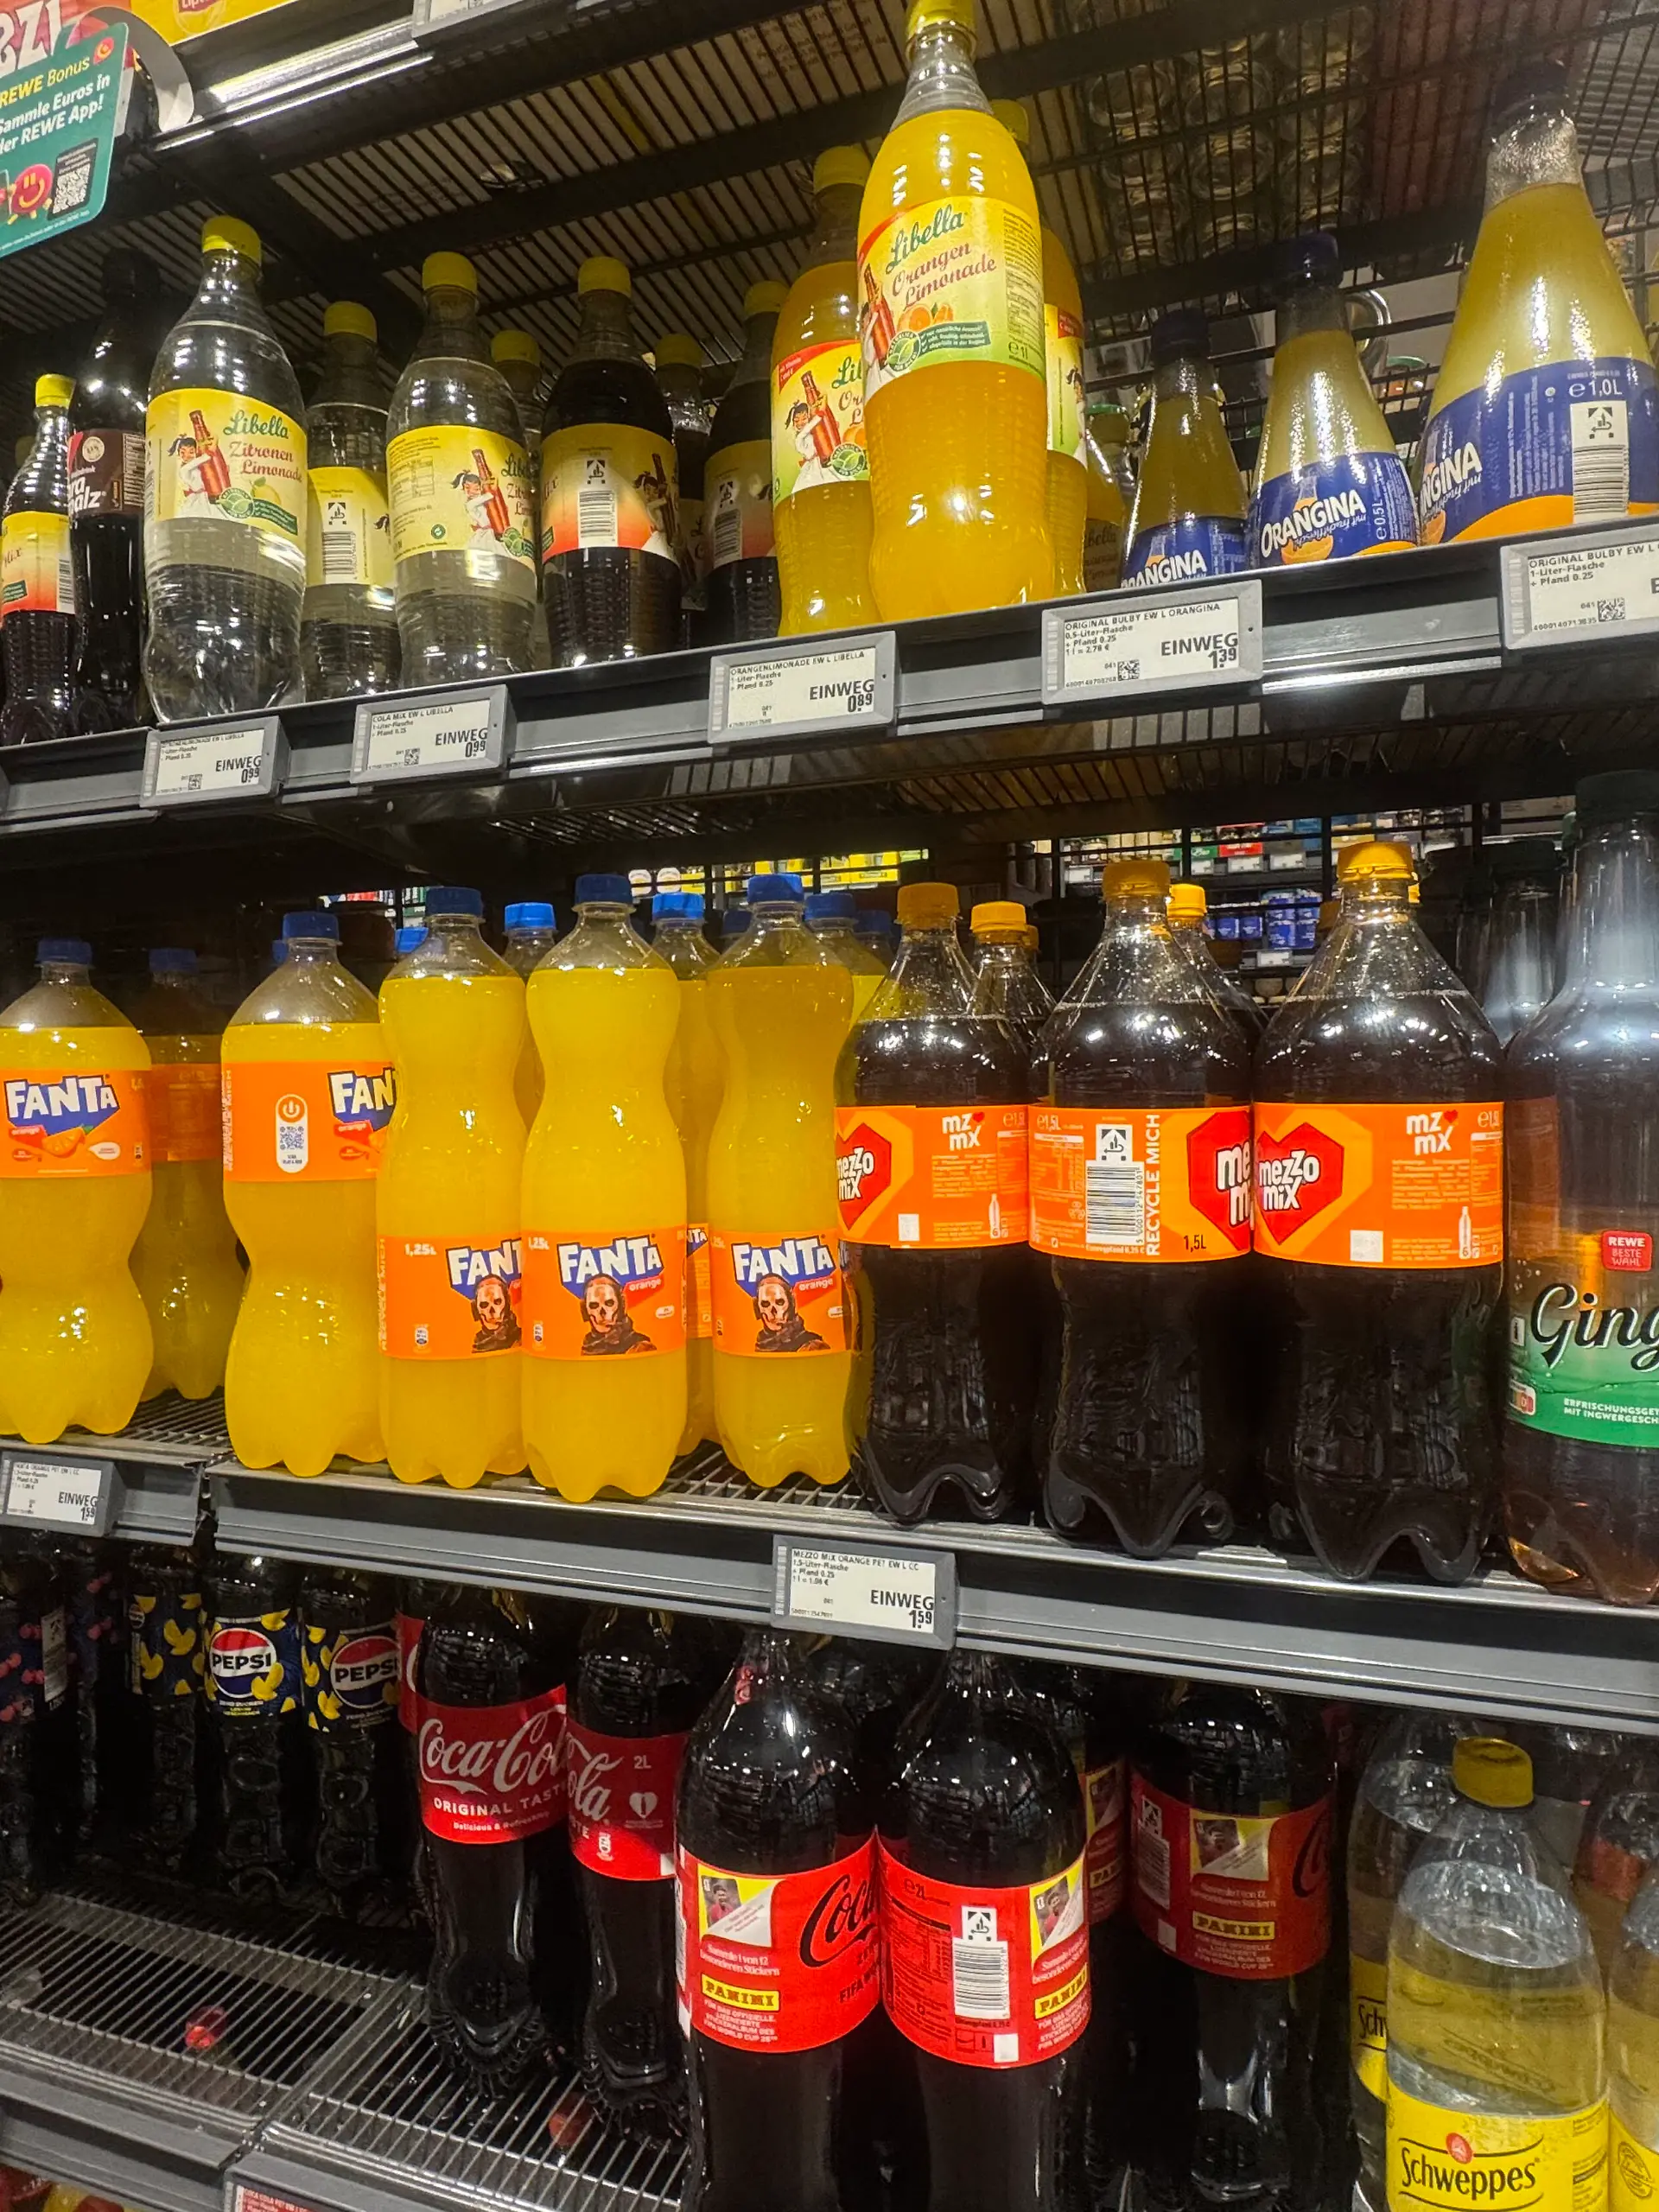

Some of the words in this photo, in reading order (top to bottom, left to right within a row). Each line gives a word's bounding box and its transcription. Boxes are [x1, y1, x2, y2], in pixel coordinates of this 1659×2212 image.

[0, 75, 44, 108] REWE
[47, 57, 90, 86] Bonus
[53, 83, 94, 111] Euros
[96, 73, 111, 91] in
[21, 111, 66, 145] REWE
[68, 93, 104, 124] App!
[886, 204, 963, 275] Libella
[892, 242, 971, 296] Orangen
[904, 253, 997, 311] Limonade
[1588, 379, 1623, 397] 1,0L
[223, 410, 289, 439] Libella
[229, 441, 294, 462] Zitronen
[240, 459, 302, 483] Limonade
[1262, 489, 1367, 558] ORANGINA
[1529, 555, 1583, 568] ORIGINAL
[1587, 548, 1623, 560] BULBY
[1627, 545, 1644, 555] EW
[1530, 562, 1605, 577] 1-Liter-Flasche
[1541, 575, 1569, 586] Pfand
[1573, 571, 1593, 582] 0.25
[1065, 619, 1109, 630] ORIGINAL
[1112, 614, 1141, 624] BULBY
[1144, 612, 1158, 621] EW
[1169, 603, 1220, 617] ORANGINA
[1065, 625, 1133, 639] 0.5-Liter-Flasche
[1073, 638, 1097, 647] Pfand
[1099, 634, 1116, 645] 0.25
[1161, 632, 1238, 657] EINWEG
[730, 658, 810, 676] ORANGENLIMONADE
[834, 651, 865, 662] LIBELLA
[810, 678, 874, 701] EINWEG
[426, 706, 454, 716] LIBELLA
[435, 728, 488, 746] EINWEG
[216, 755, 262, 772] EINWEG
[5, 1077, 118, 1120] FANTA
[330, 1070, 395, 1114] FAN
[942, 1113, 972, 1134] mz
[1407, 1112, 1443, 1135] mz
[1146, 1115, 1160, 1164] MICH
[1146, 1169, 1160, 1256] RECYCLE
[1183, 1234, 1206, 1252] 1,5L
[1608, 1236, 1645, 1247] REWE
[1612, 1248, 1642, 1258] BESTE
[448, 1238, 522, 1286] FANT
[558, 1236, 662, 1283] FANTA
[732, 1237, 834, 1282] FANTA
[1612, 1257, 1642, 1267] WAHL
[629, 1278, 661, 1291] orange
[798, 1277, 834, 1291] orange
[1564, 1407, 1581, 1416] MIT
[58, 1491, 99, 1507] EINWEG
[793, 1550, 818, 1560] MEZZO
[821, 1553, 836, 1561] MIX
[838, 1555, 870, 1566] ORANGE
[872, 1559, 886, 1567] PET
[870, 1590, 934, 1611] EINWEG
[213, 1652, 271, 1670] PEPSI
[335, 1657, 399, 1683] PEPSI
[633, 1755, 652, 1769] 2L
[434, 1797, 512, 1816] ORIGINAL
[520, 1783, 563, 1808] TAST
[1197, 1915, 1270, 1936] PANINI
[742, 1956, 759, 1965] von
[706, 1980, 774, 2006] PANINI
[1402, 2146, 1535, 2201] Schweppes
